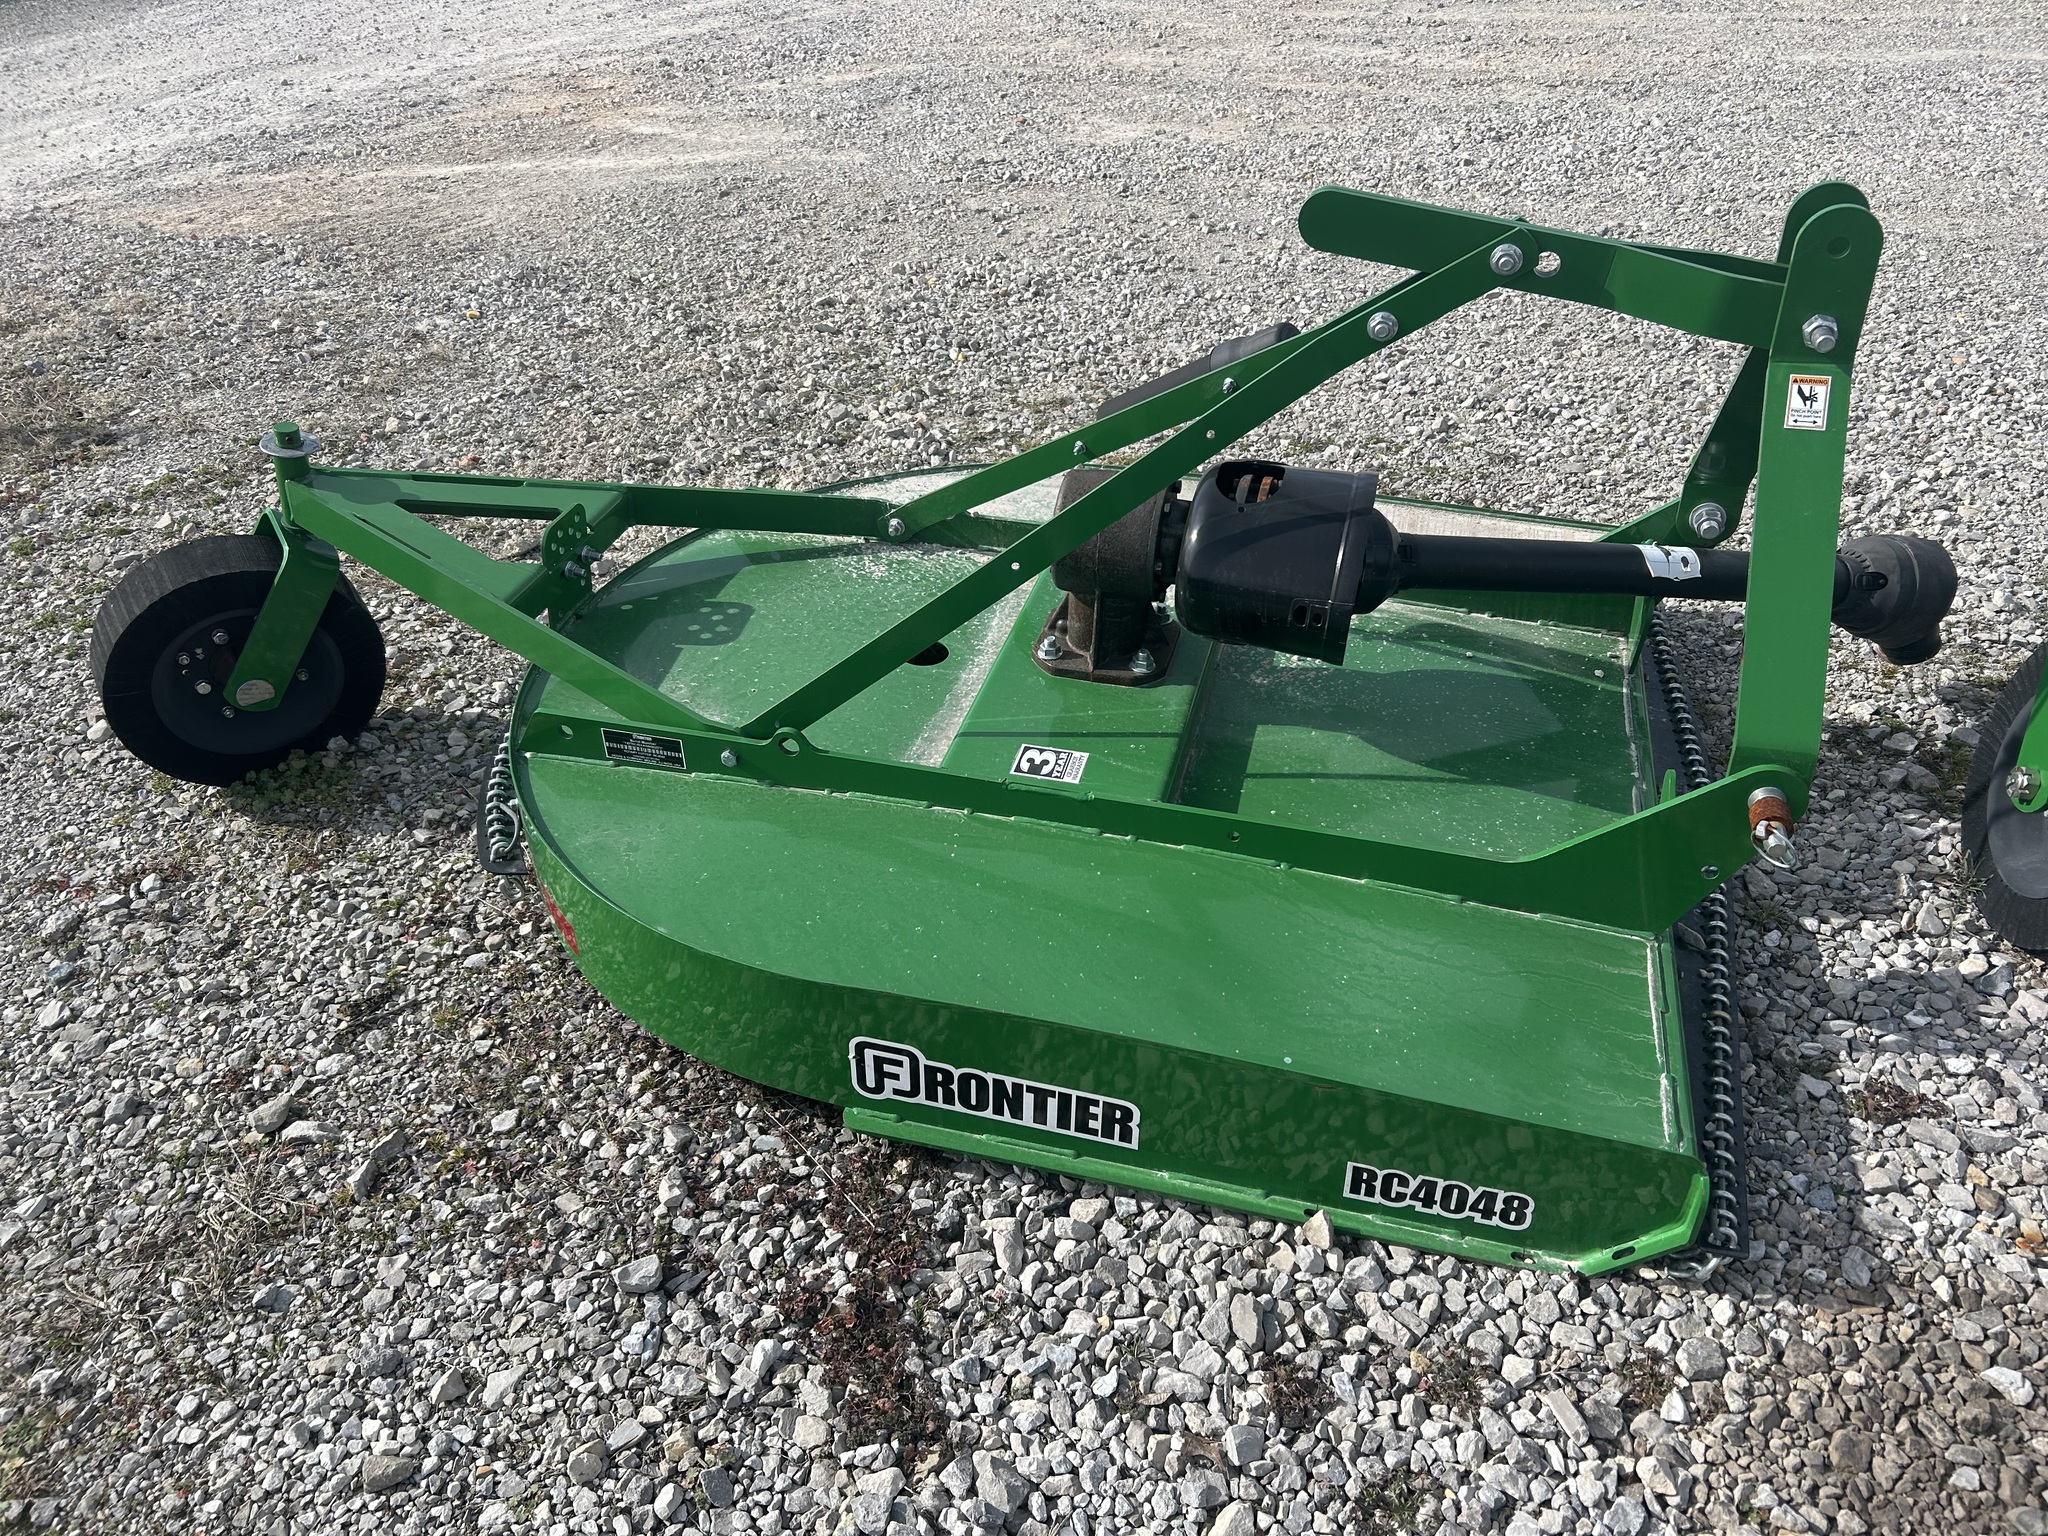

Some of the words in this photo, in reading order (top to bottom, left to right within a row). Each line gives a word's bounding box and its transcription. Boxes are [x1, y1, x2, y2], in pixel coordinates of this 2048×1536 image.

[1020, 748, 1057, 776] 3
[1051, 752, 1069, 778] YEAR
[1071, 754, 1086, 781] WARRANTY
[853, 1039, 1135, 1146] FRONTIER
[1347, 1164, 1531, 1228] RC4048
